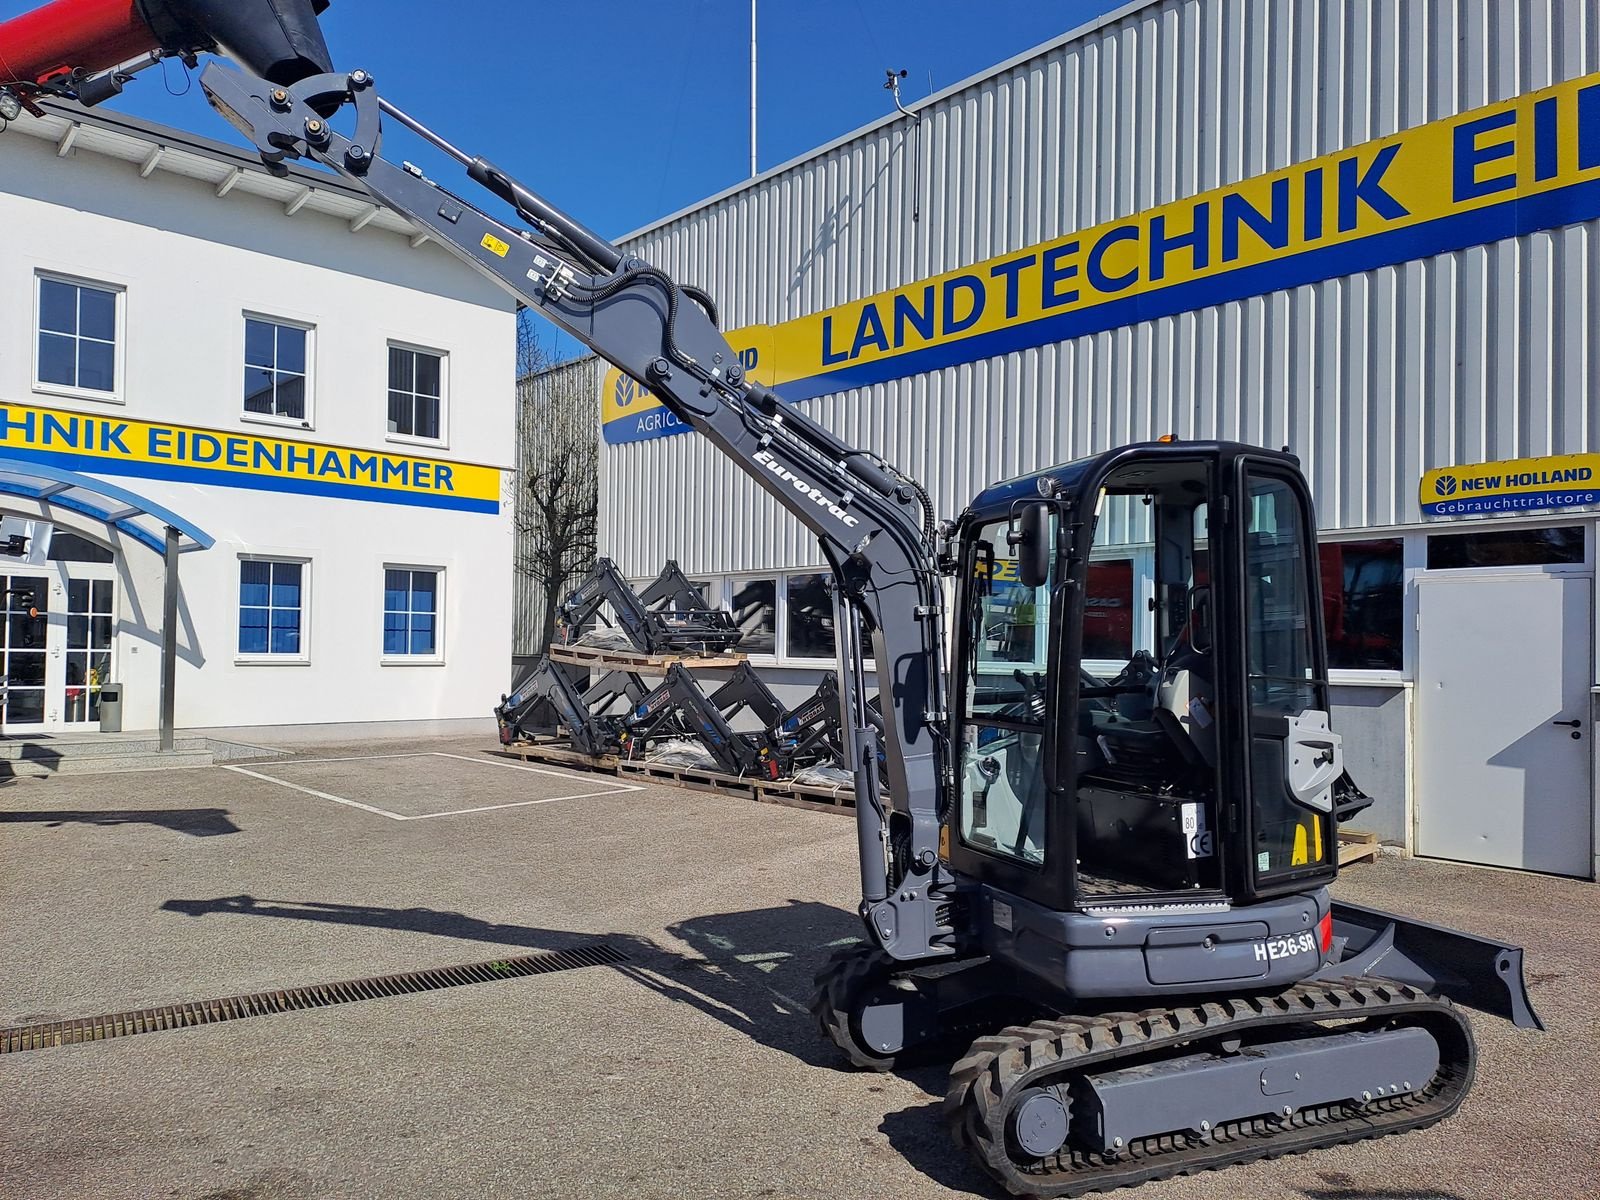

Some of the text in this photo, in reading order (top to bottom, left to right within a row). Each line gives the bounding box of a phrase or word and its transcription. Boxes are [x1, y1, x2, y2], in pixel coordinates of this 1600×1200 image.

[821, 143, 1410, 366] LANDTECHNIK
[148, 427, 454, 491] EIDENHAMMER
[752, 451, 859, 528] Eurotrac
[1461, 467, 1592, 491] NEW HOLLAND
[1435, 493, 1593, 514] Gebrauchttraktore
[1184, 816, 1195, 829] 80
[1190, 833, 1211, 855] CE
[1254, 933, 1316, 961] HE26-SR
